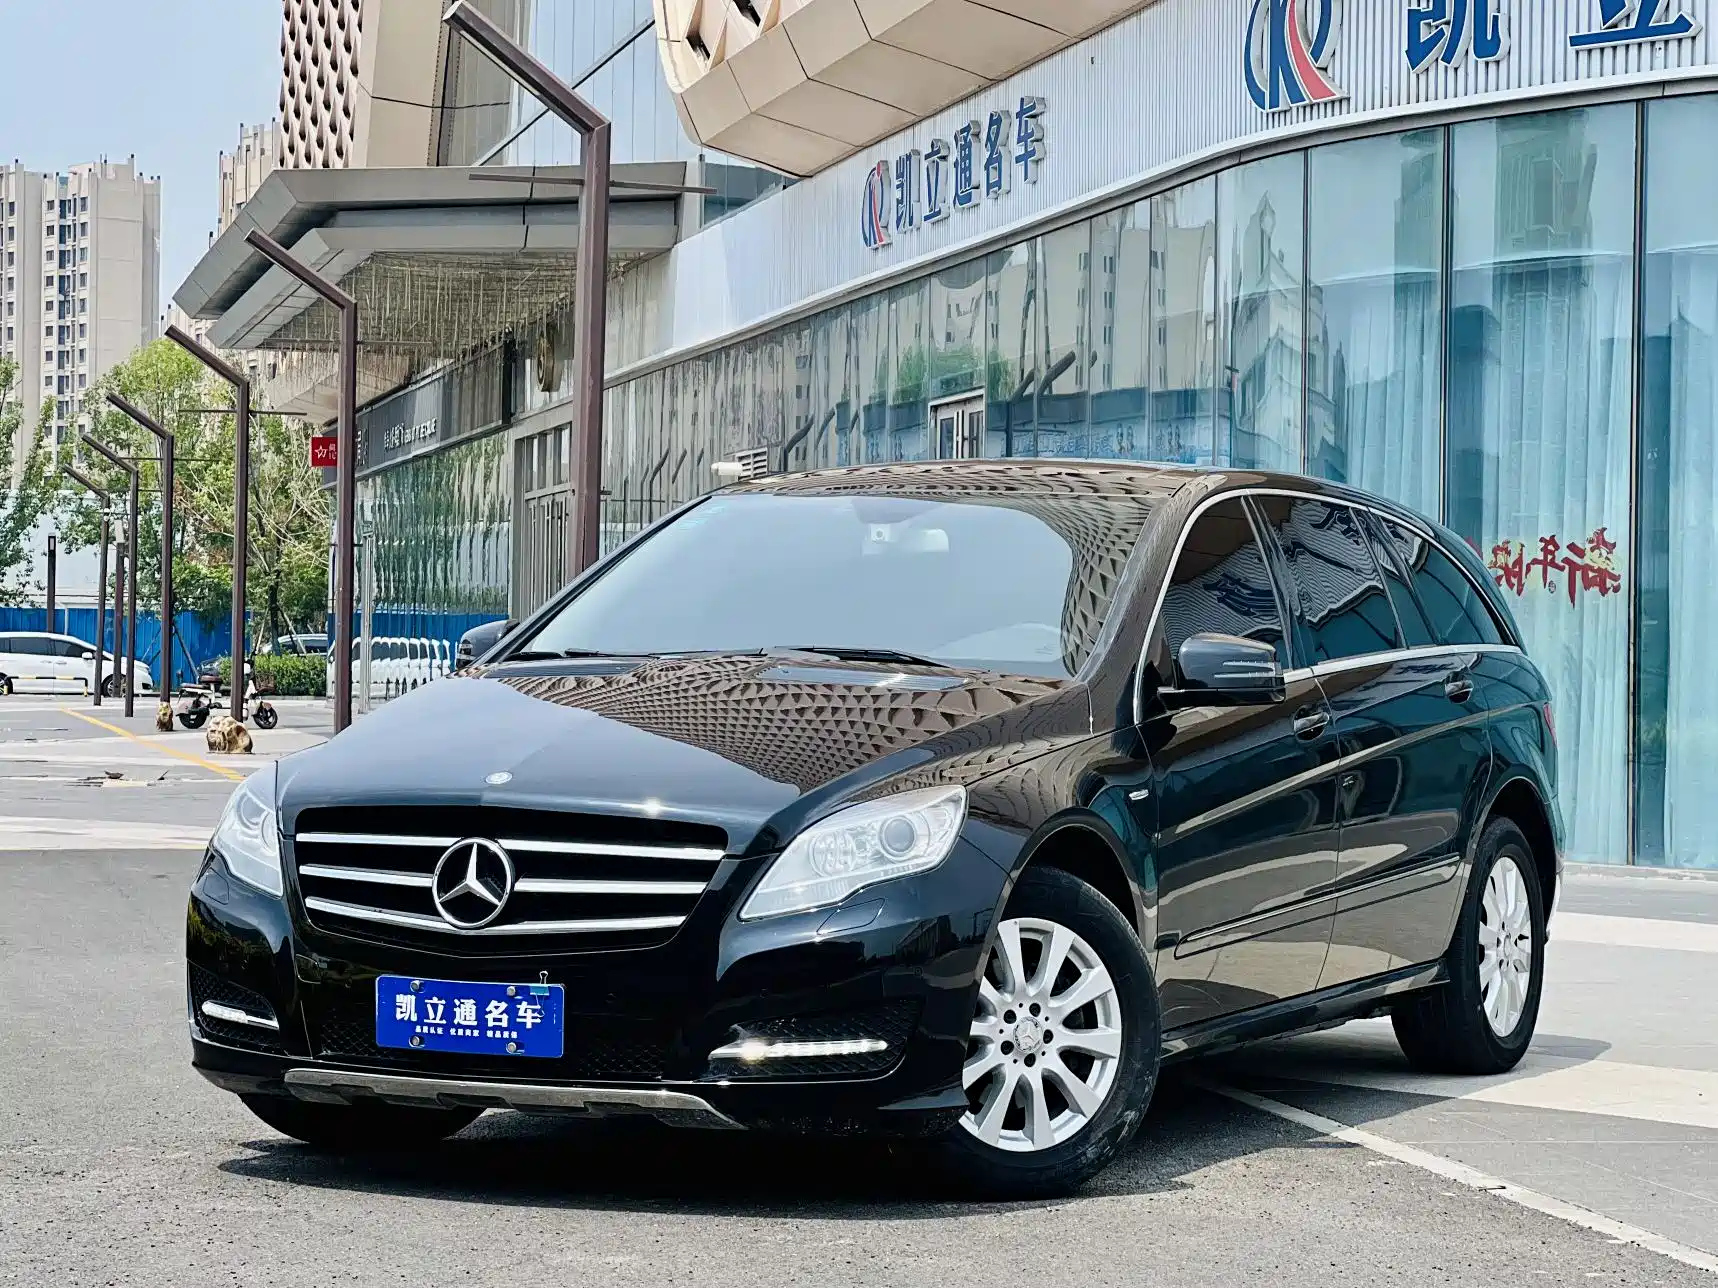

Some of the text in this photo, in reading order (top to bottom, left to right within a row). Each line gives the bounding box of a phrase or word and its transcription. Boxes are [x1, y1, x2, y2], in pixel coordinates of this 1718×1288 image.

[895, 95, 1045, 234] 凯立通名车
[395, 994, 542, 1029] 凯立通名车
